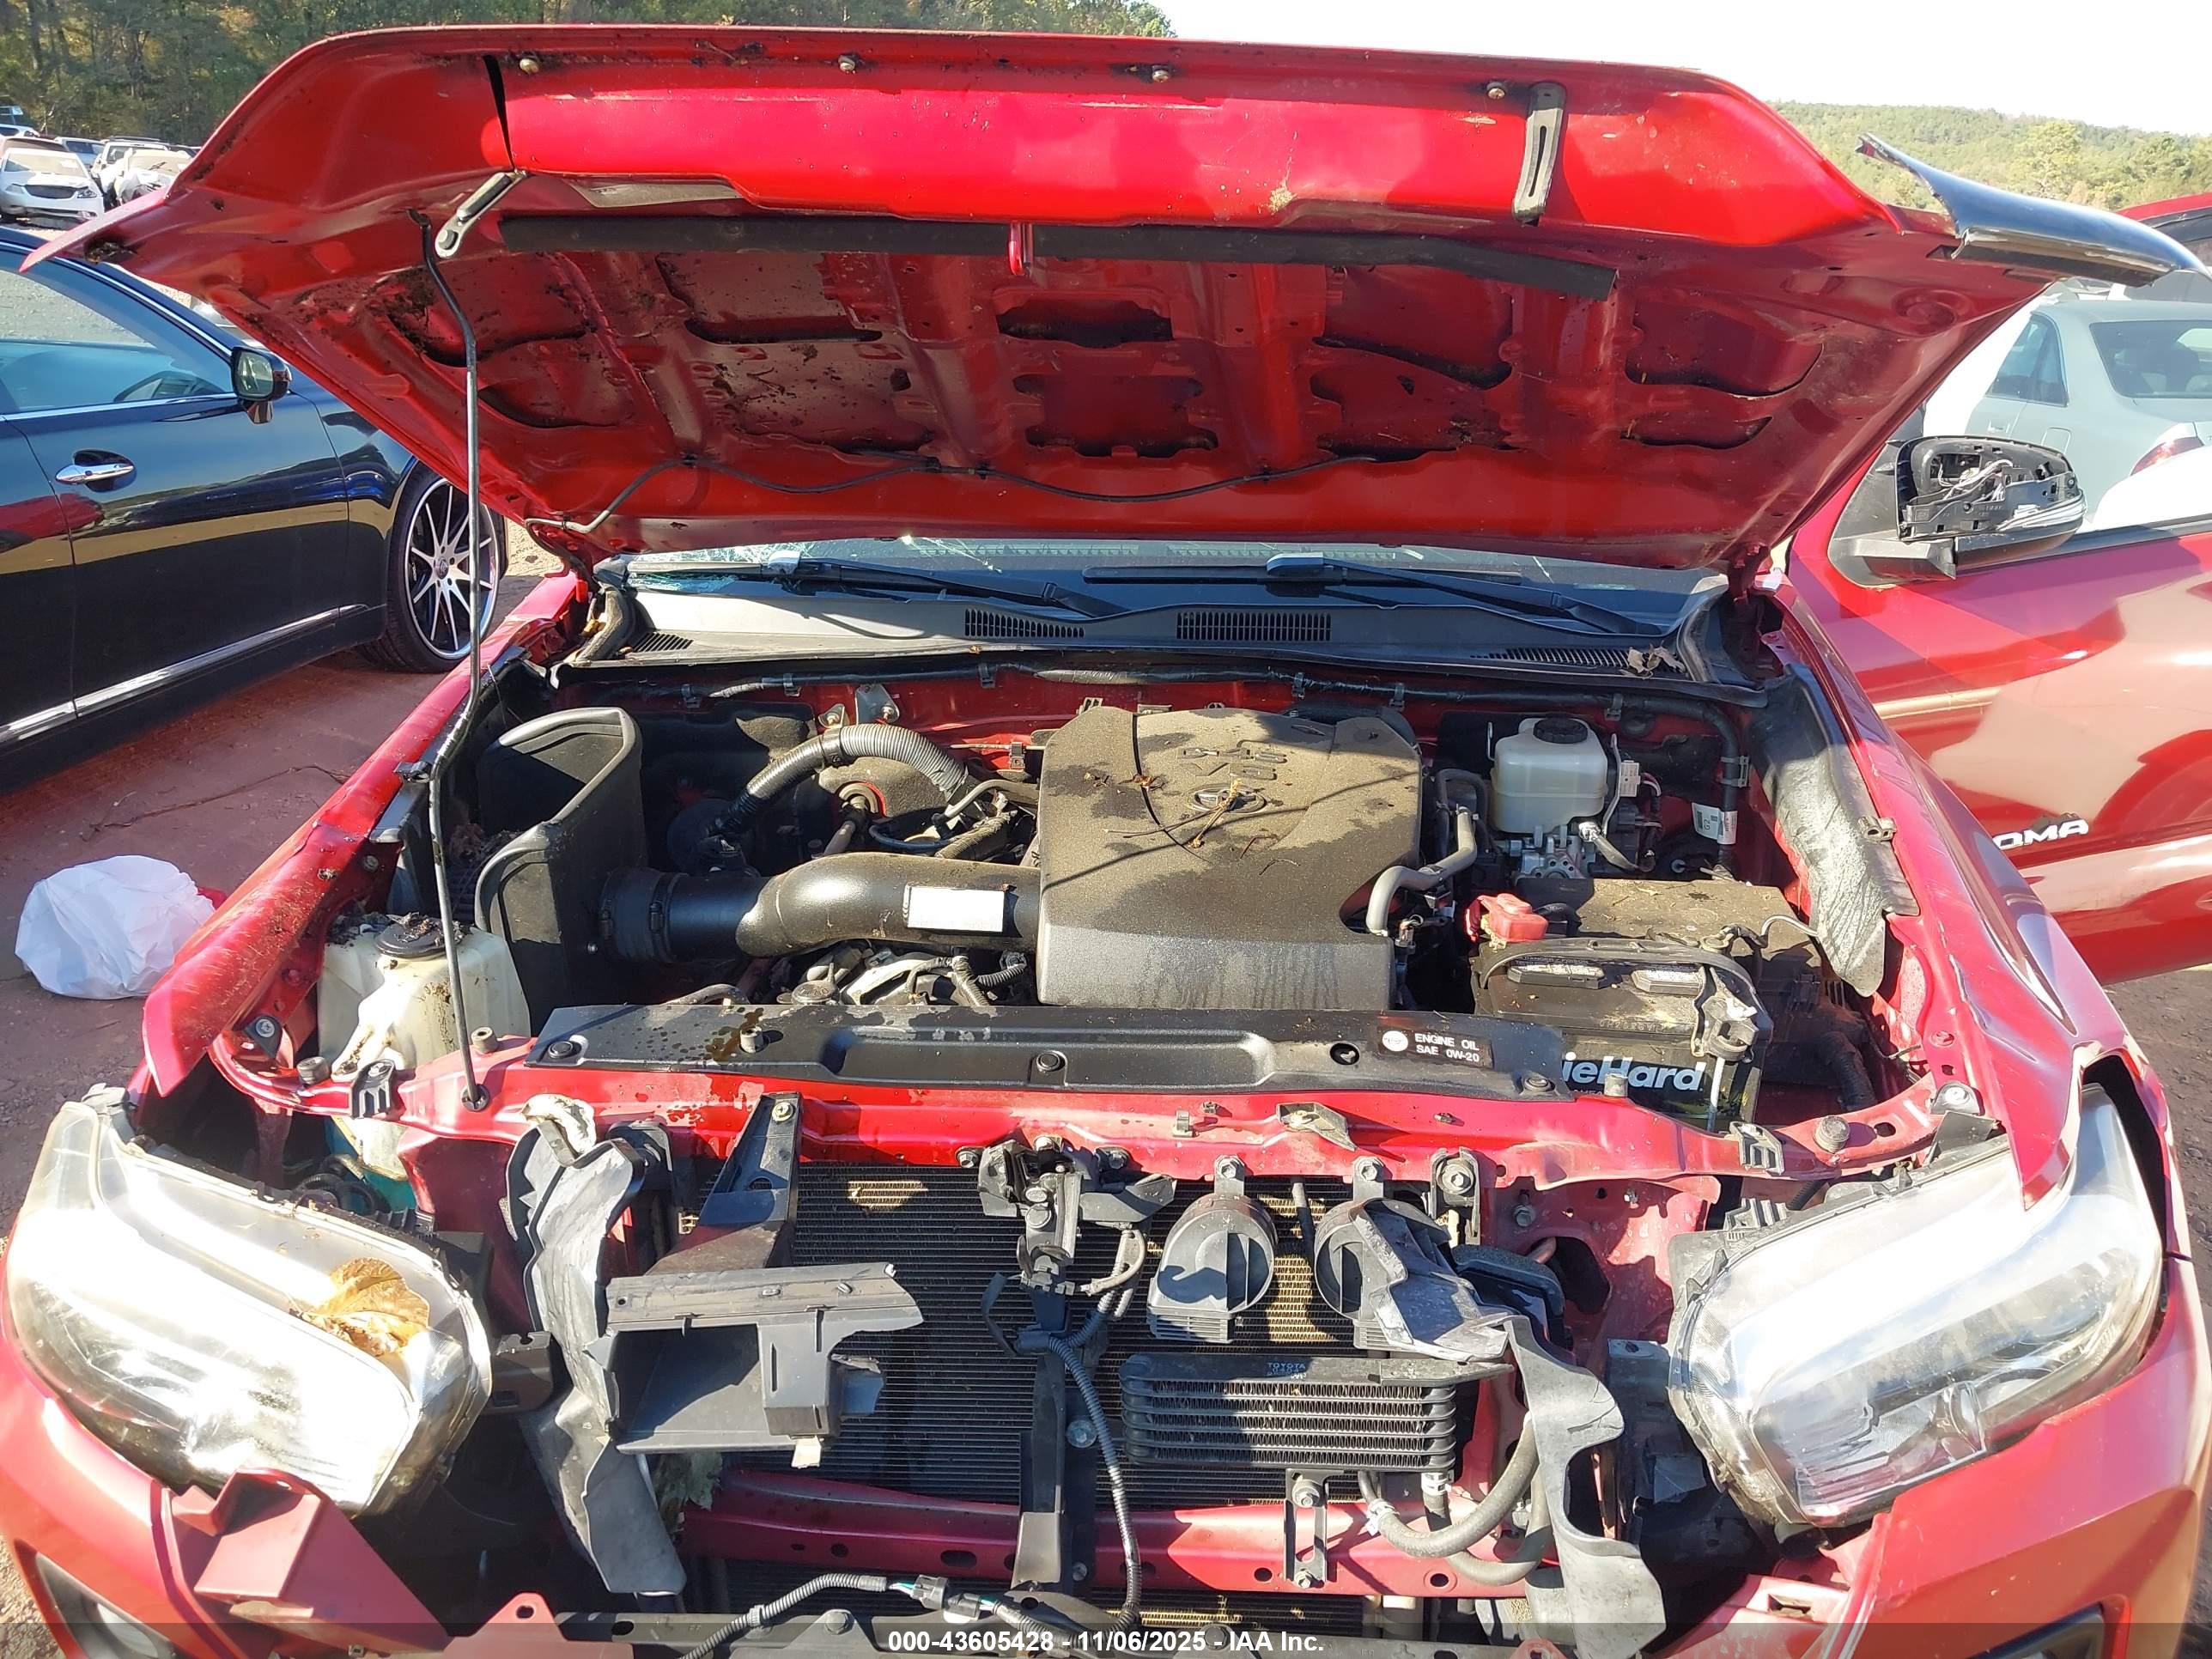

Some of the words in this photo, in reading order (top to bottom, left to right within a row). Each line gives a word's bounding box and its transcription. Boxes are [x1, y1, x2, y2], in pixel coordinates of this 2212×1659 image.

[1992, 818, 2089, 851] OMA
[1414, 1032, 1455, 1048] ENGINE
[1461, 1039, 1480, 1052] OIL
[1416, 1044, 1439, 1056] SAE
[1446, 1048, 1480, 1063] 0W-20
[1562, 1051, 1707, 1091] ieHard
